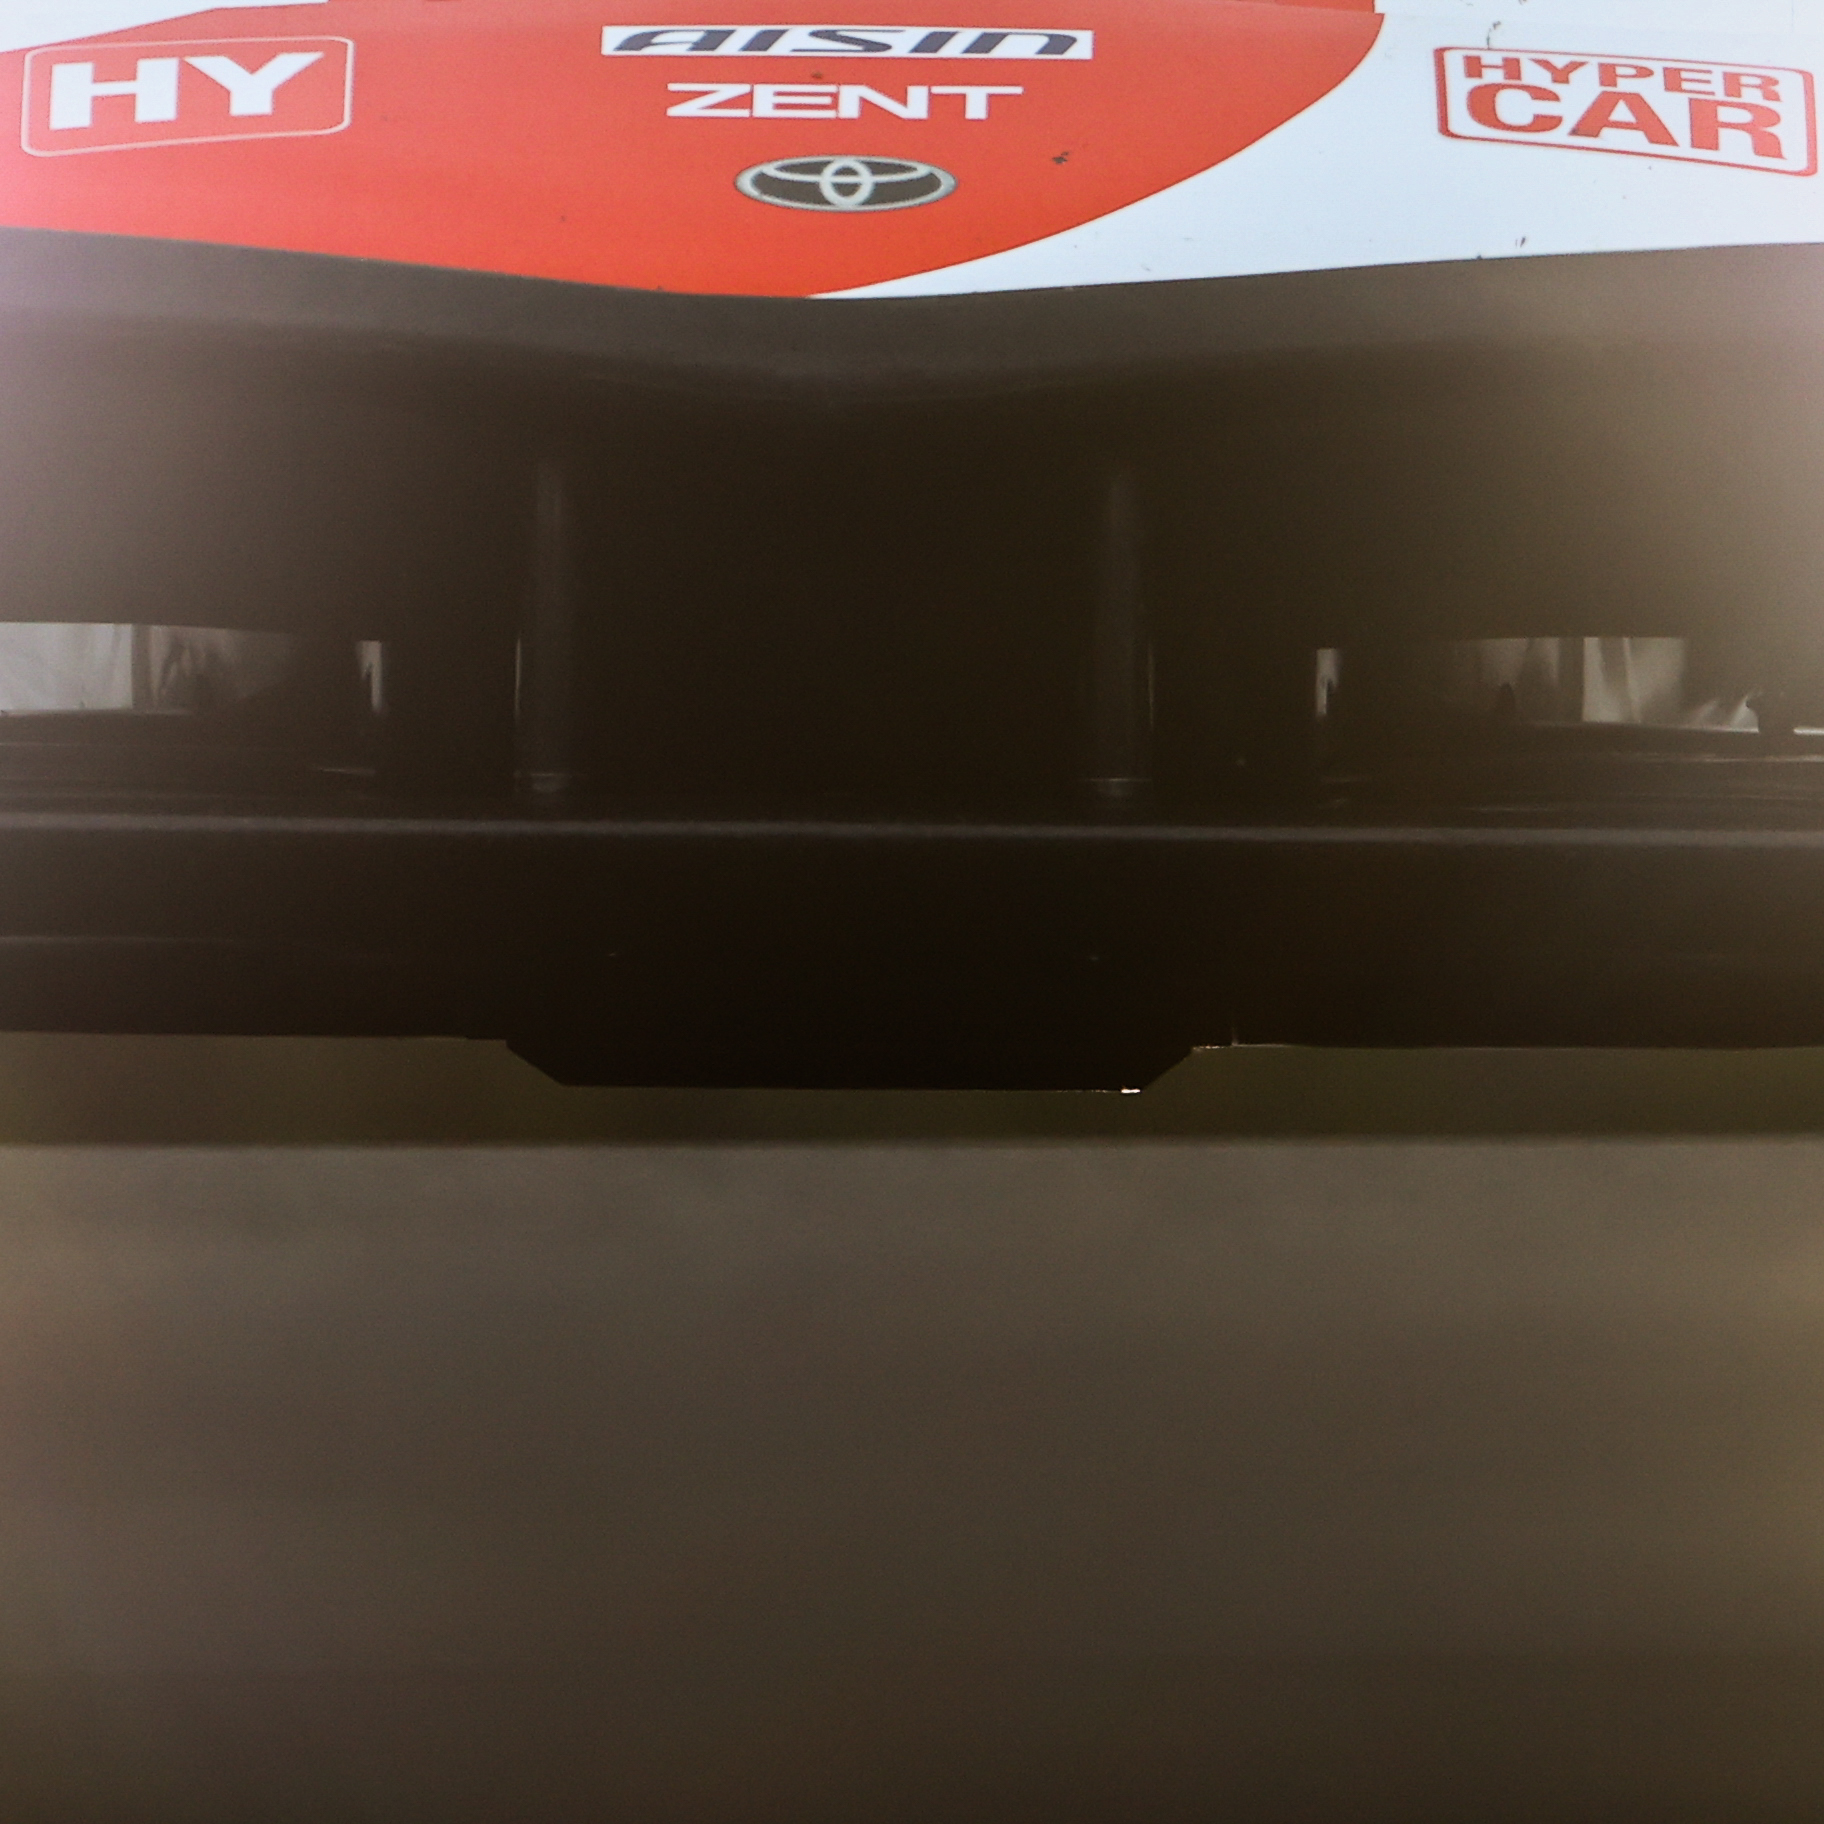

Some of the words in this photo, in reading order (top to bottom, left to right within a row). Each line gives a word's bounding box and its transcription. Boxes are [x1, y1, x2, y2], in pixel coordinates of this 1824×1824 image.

[613, 28, 1078, 57] AISIN
[49, 52, 325, 131] HY
[666, 82, 1024, 121] ZENT
[1462, 54, 1783, 103] HYPER
[1466, 82, 1788, 160] CAR
